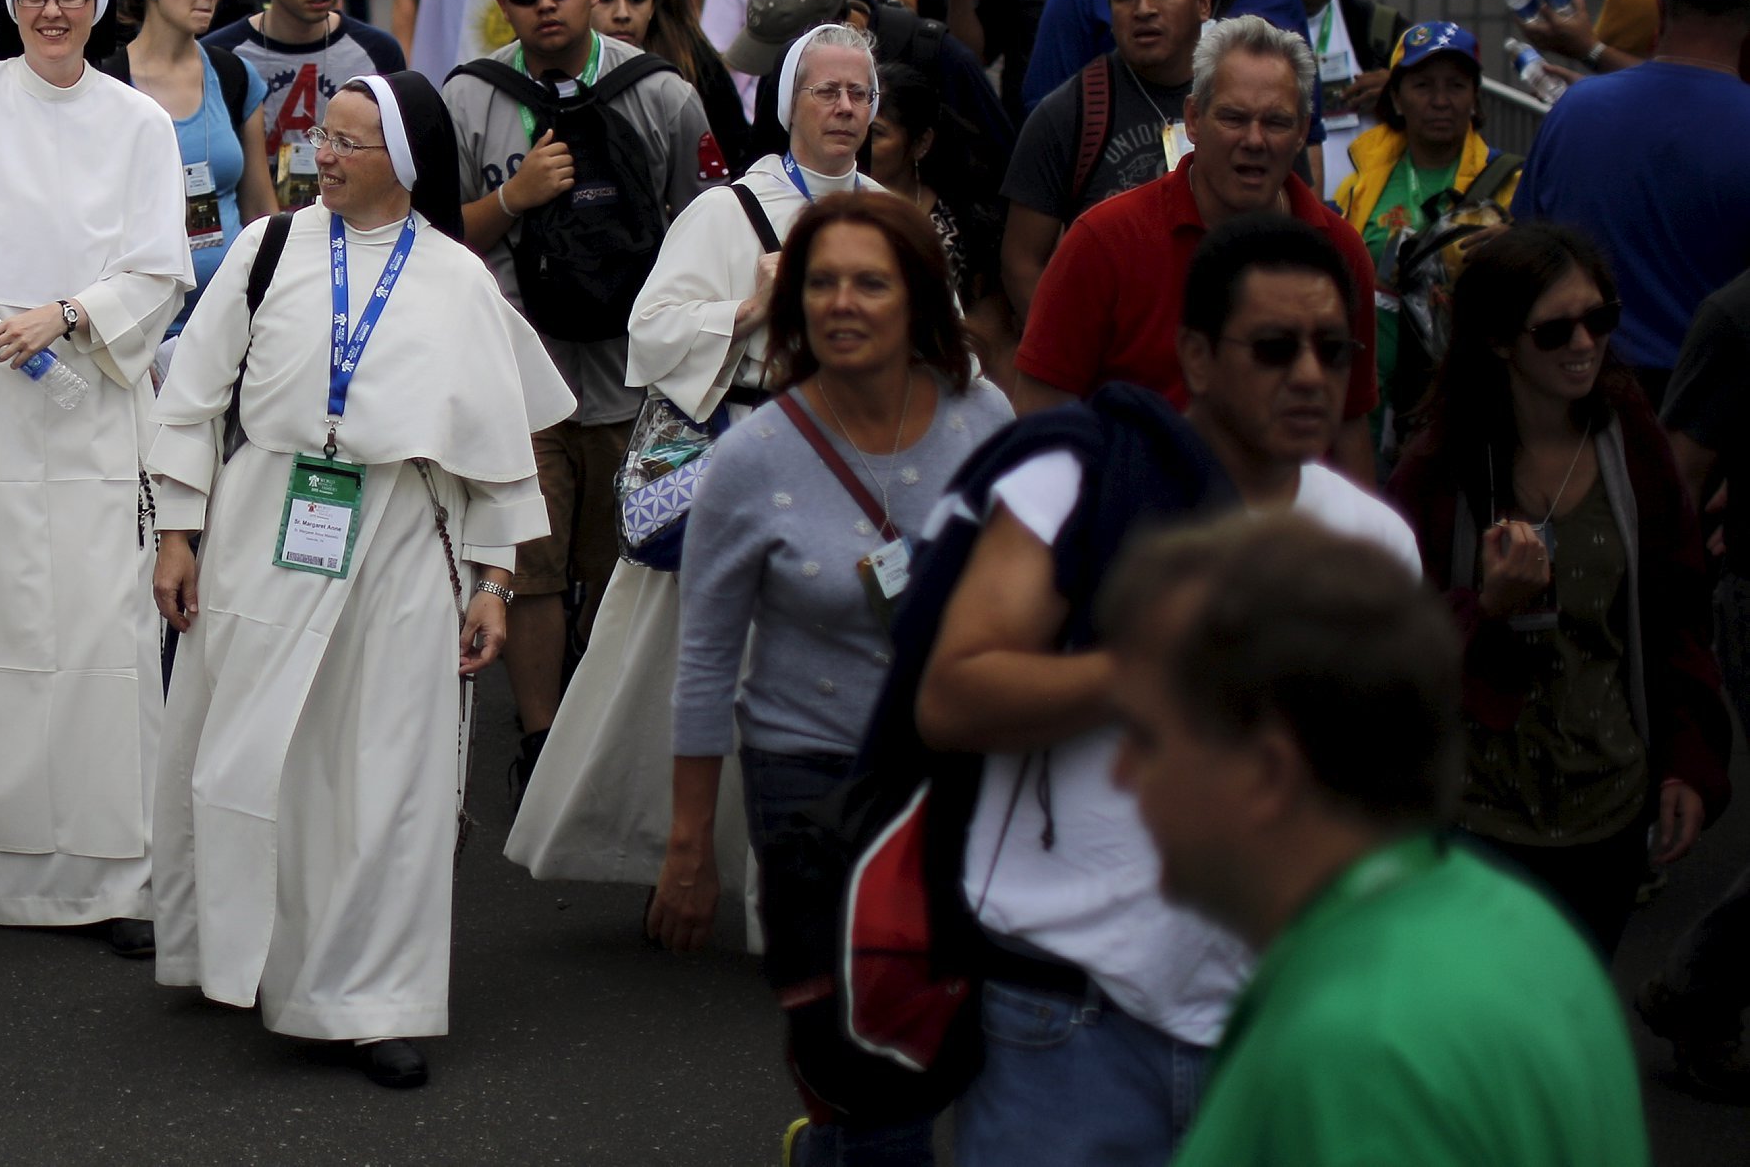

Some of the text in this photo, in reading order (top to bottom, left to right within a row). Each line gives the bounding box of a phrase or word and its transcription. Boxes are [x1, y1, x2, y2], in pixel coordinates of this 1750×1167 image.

[265, 63, 319, 157] A
[302, 520, 326, 529] Margaret
[326, 524, 342, 532] Anne
